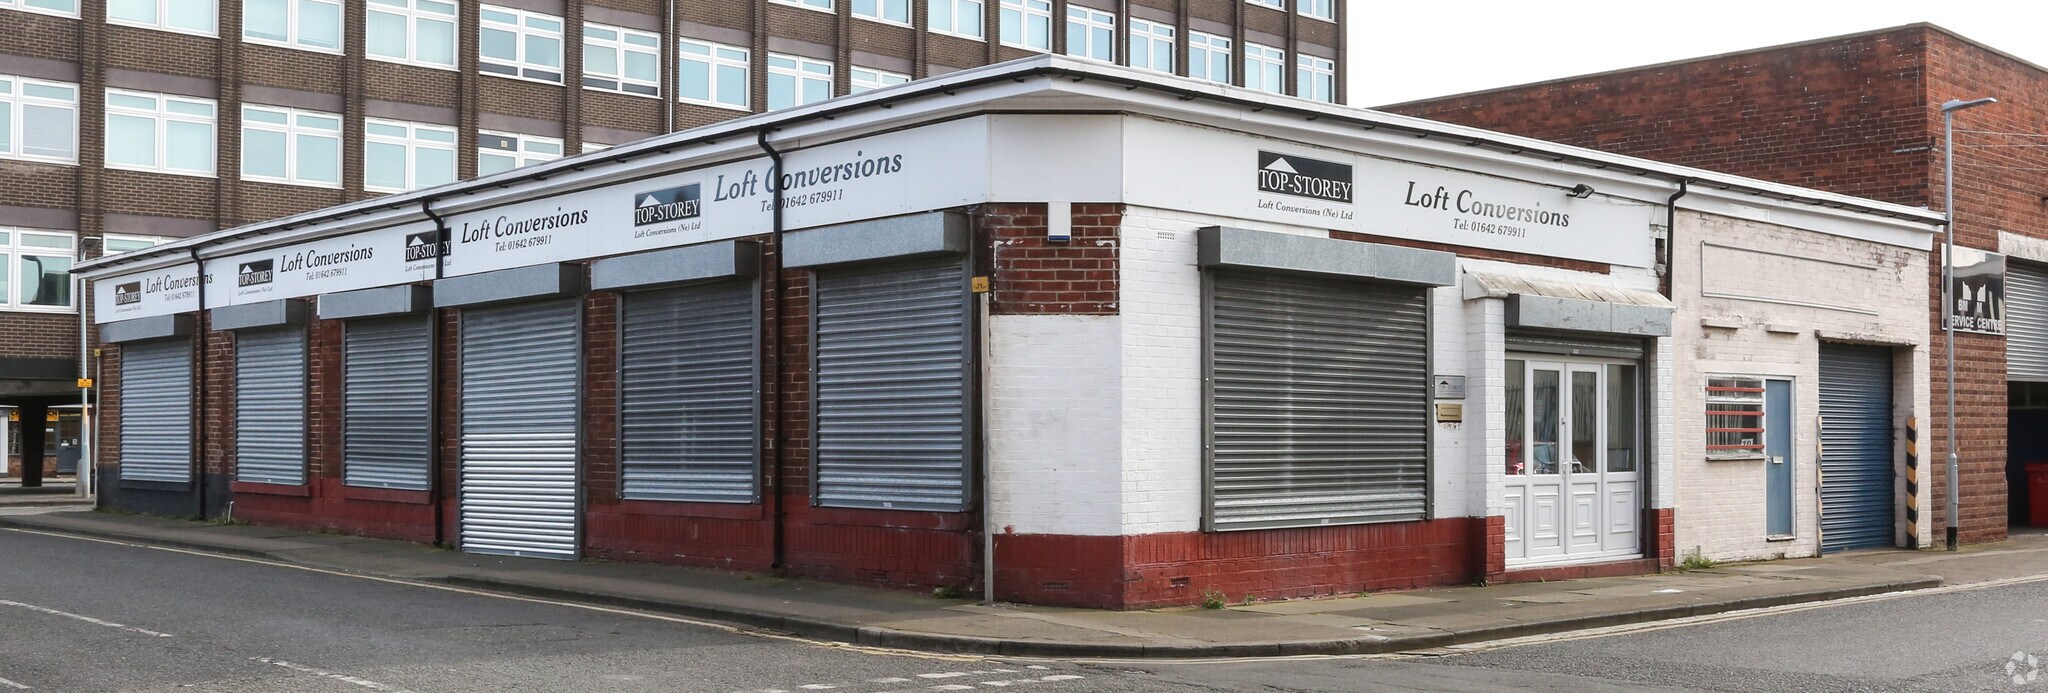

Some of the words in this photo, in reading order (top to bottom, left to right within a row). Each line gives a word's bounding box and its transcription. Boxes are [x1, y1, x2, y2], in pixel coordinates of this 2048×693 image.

[714, 169, 757, 202] Loft
[765, 150, 902, 193] Conversions
[1258, 169, 1351, 200] TOP-STOREY
[809, 189, 843, 204] 679911
[1404, 181, 1449, 210] Loft
[1456, 189, 1569, 227] Conversions
[635, 199, 700, 224] TOP-STOREY
[1257, 199, 1273, 210] Loft
[1275, 202, 1320, 216] Conversions
[1322, 208, 1338, 219] (Ne)
[1340, 210, 1353, 220] Ltd
[461, 219, 490, 244] Loft
[494, 206, 588, 238] Conversions
[646, 227, 676, 237] Conversions
[691, 221, 701, 230] Ltd
[1453, 218, 1468, 231] Tel:
[1471, 221, 1495, 234] 01642
[1497, 225, 1526, 238] 679911
[495, 242, 506, 252] Tel:
[508, 239, 527, 250] 01642
[529, 235, 551, 247] 679911
[280, 252, 303, 272] Loft
[306, 244, 373, 268] Conversions
[146, 277, 162, 293] Loft
[164, 274, 213, 290] Conversins
[239, 270, 273, 286] TOP-STOREY
[1952, 314, 1974, 328] ERVICE
